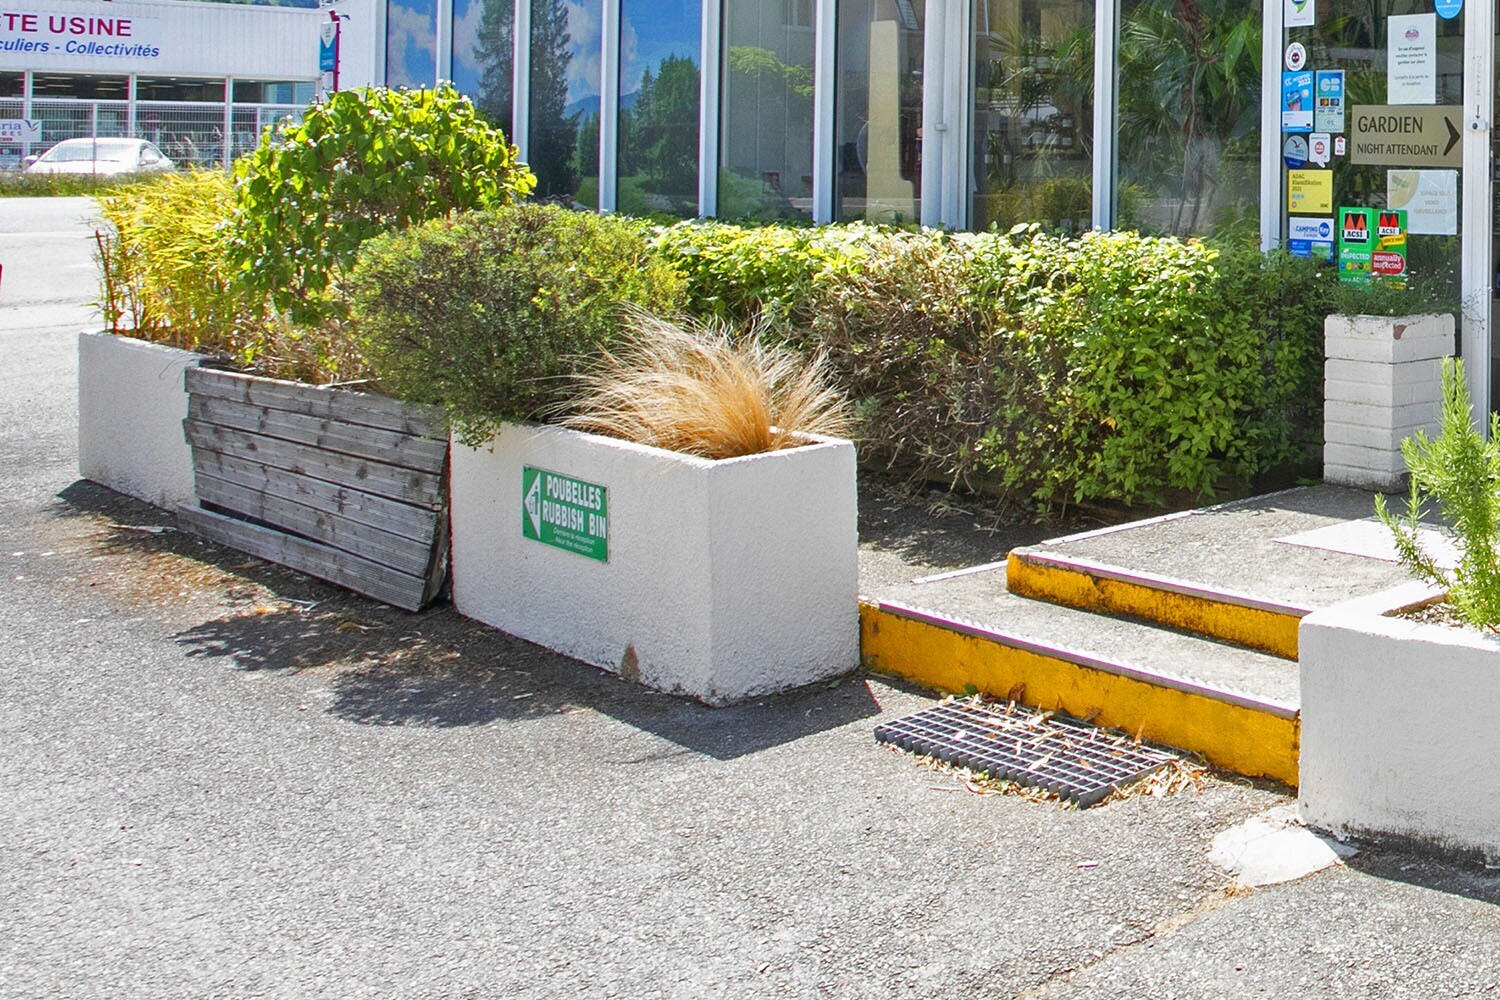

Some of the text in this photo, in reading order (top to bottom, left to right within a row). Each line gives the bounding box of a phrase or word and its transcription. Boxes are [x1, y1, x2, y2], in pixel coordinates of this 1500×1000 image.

[49, 15, 132, 37] USINE
[66, 40, 159, 58] Collectivités
[1358, 116, 1423, 133] GARDIEN
[1357, 143, 1438, 156] NIGHT ATTENDANT
[547, 475, 601, 510] POUBELLES
[542, 500, 584, 532] RUBBISH
[589, 513, 607, 539] BIN
